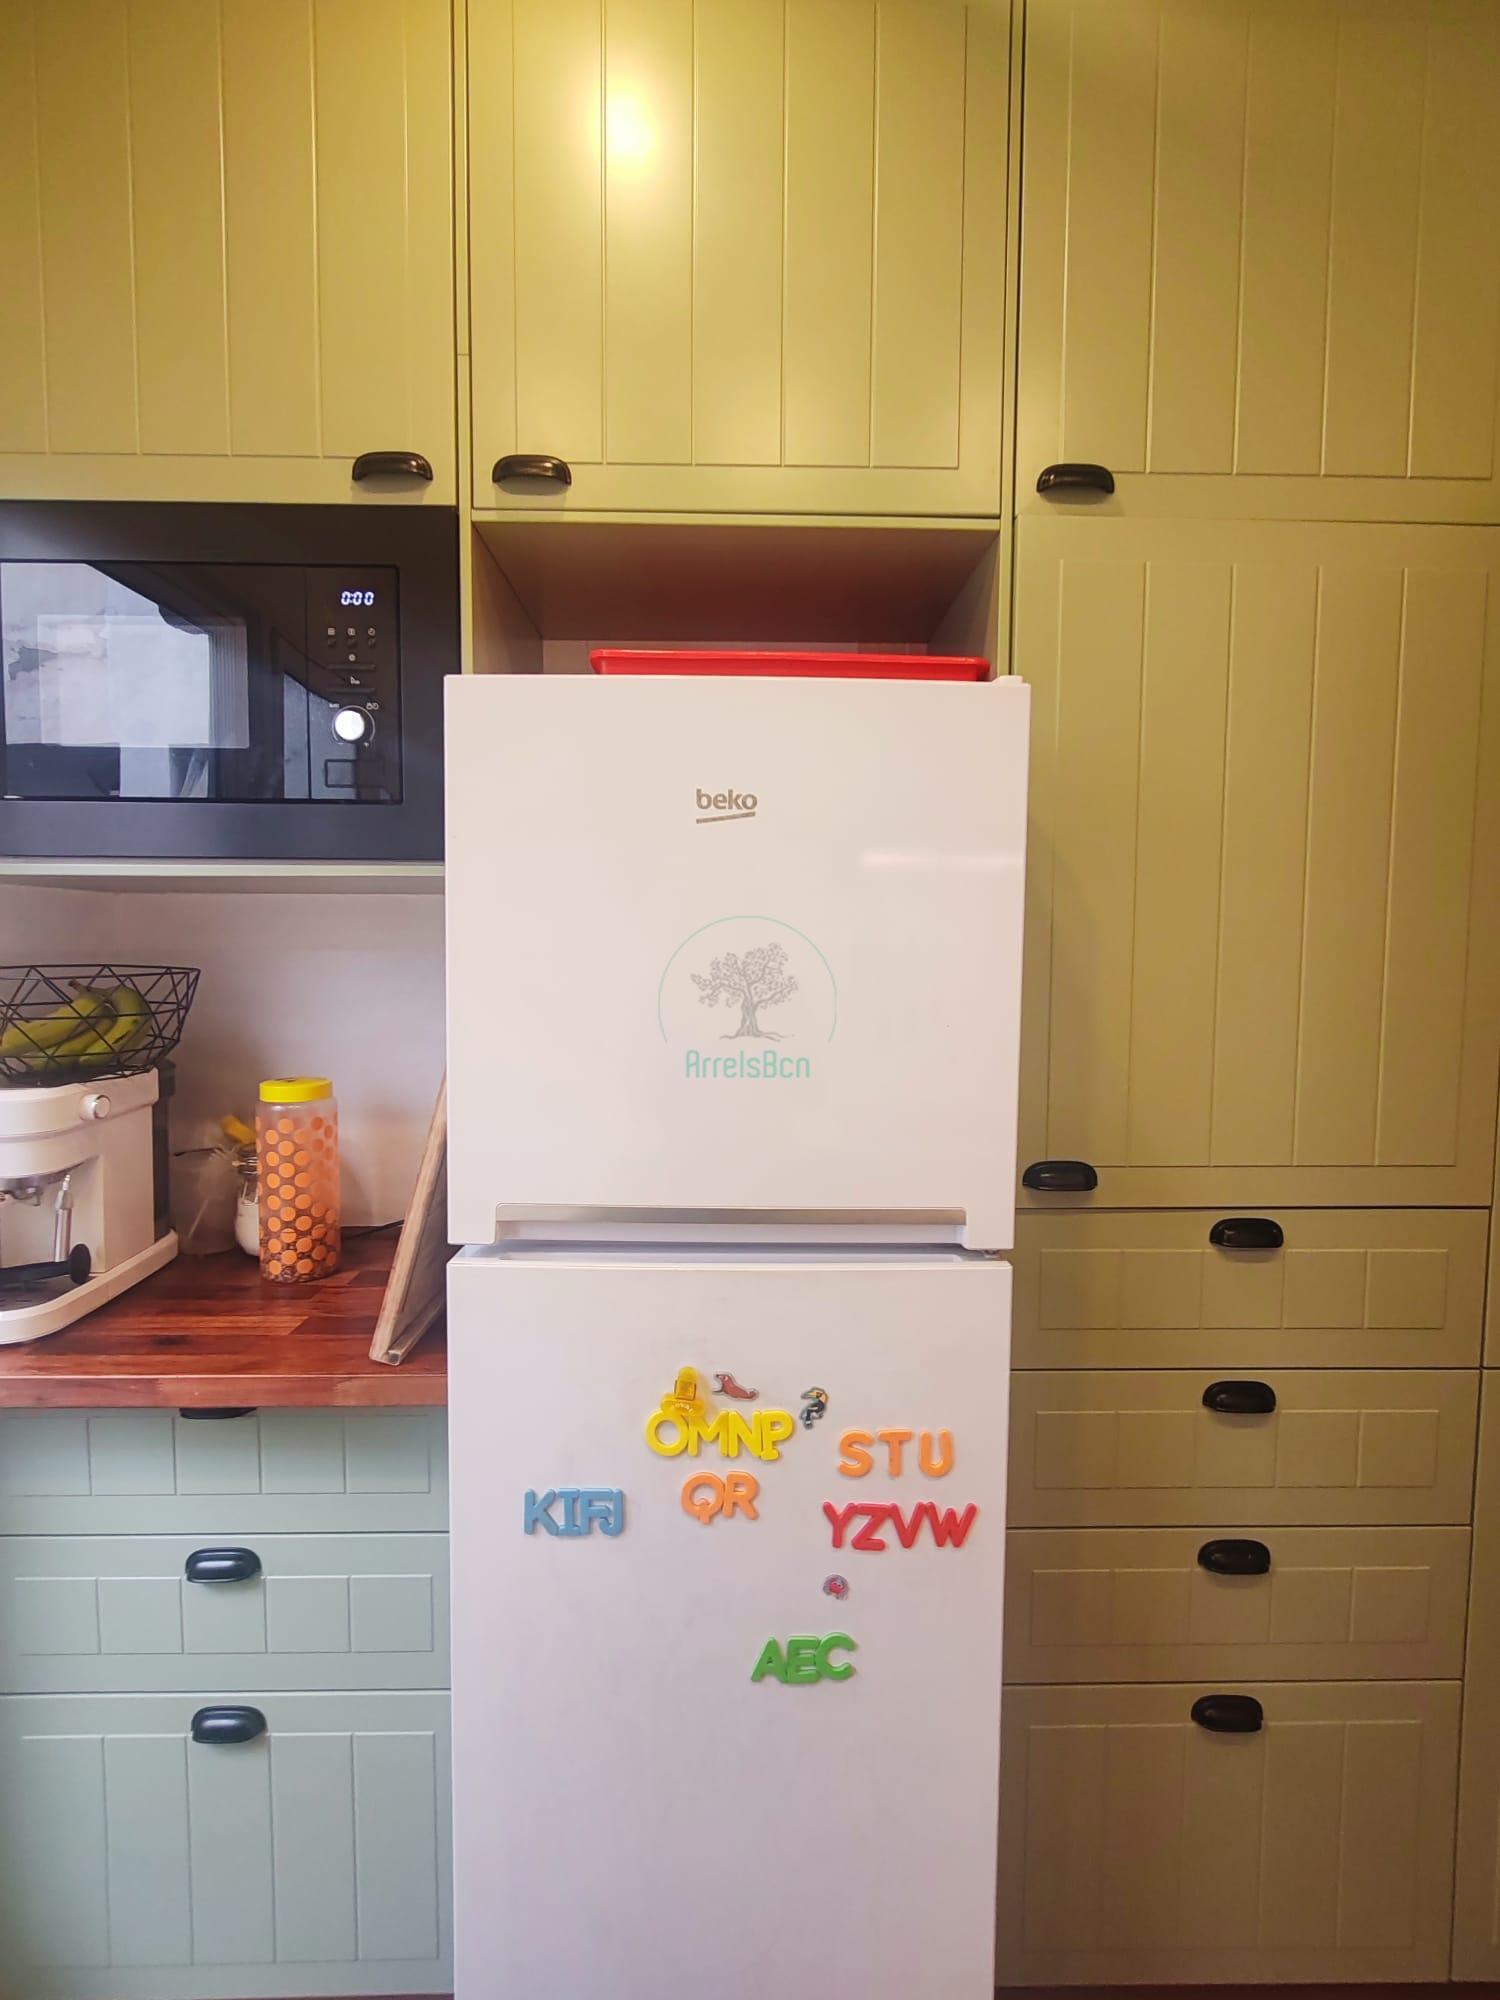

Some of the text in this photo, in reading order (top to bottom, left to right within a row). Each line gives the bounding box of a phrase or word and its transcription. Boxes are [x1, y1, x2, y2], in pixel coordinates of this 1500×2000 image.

[340, 591, 375, 606] 0:00
[696, 788, 758, 810] beko
[837, 1430, 955, 1477] STU
[681, 1472, 759, 1524] QR
[822, 1502, 977, 1551] YZVW
